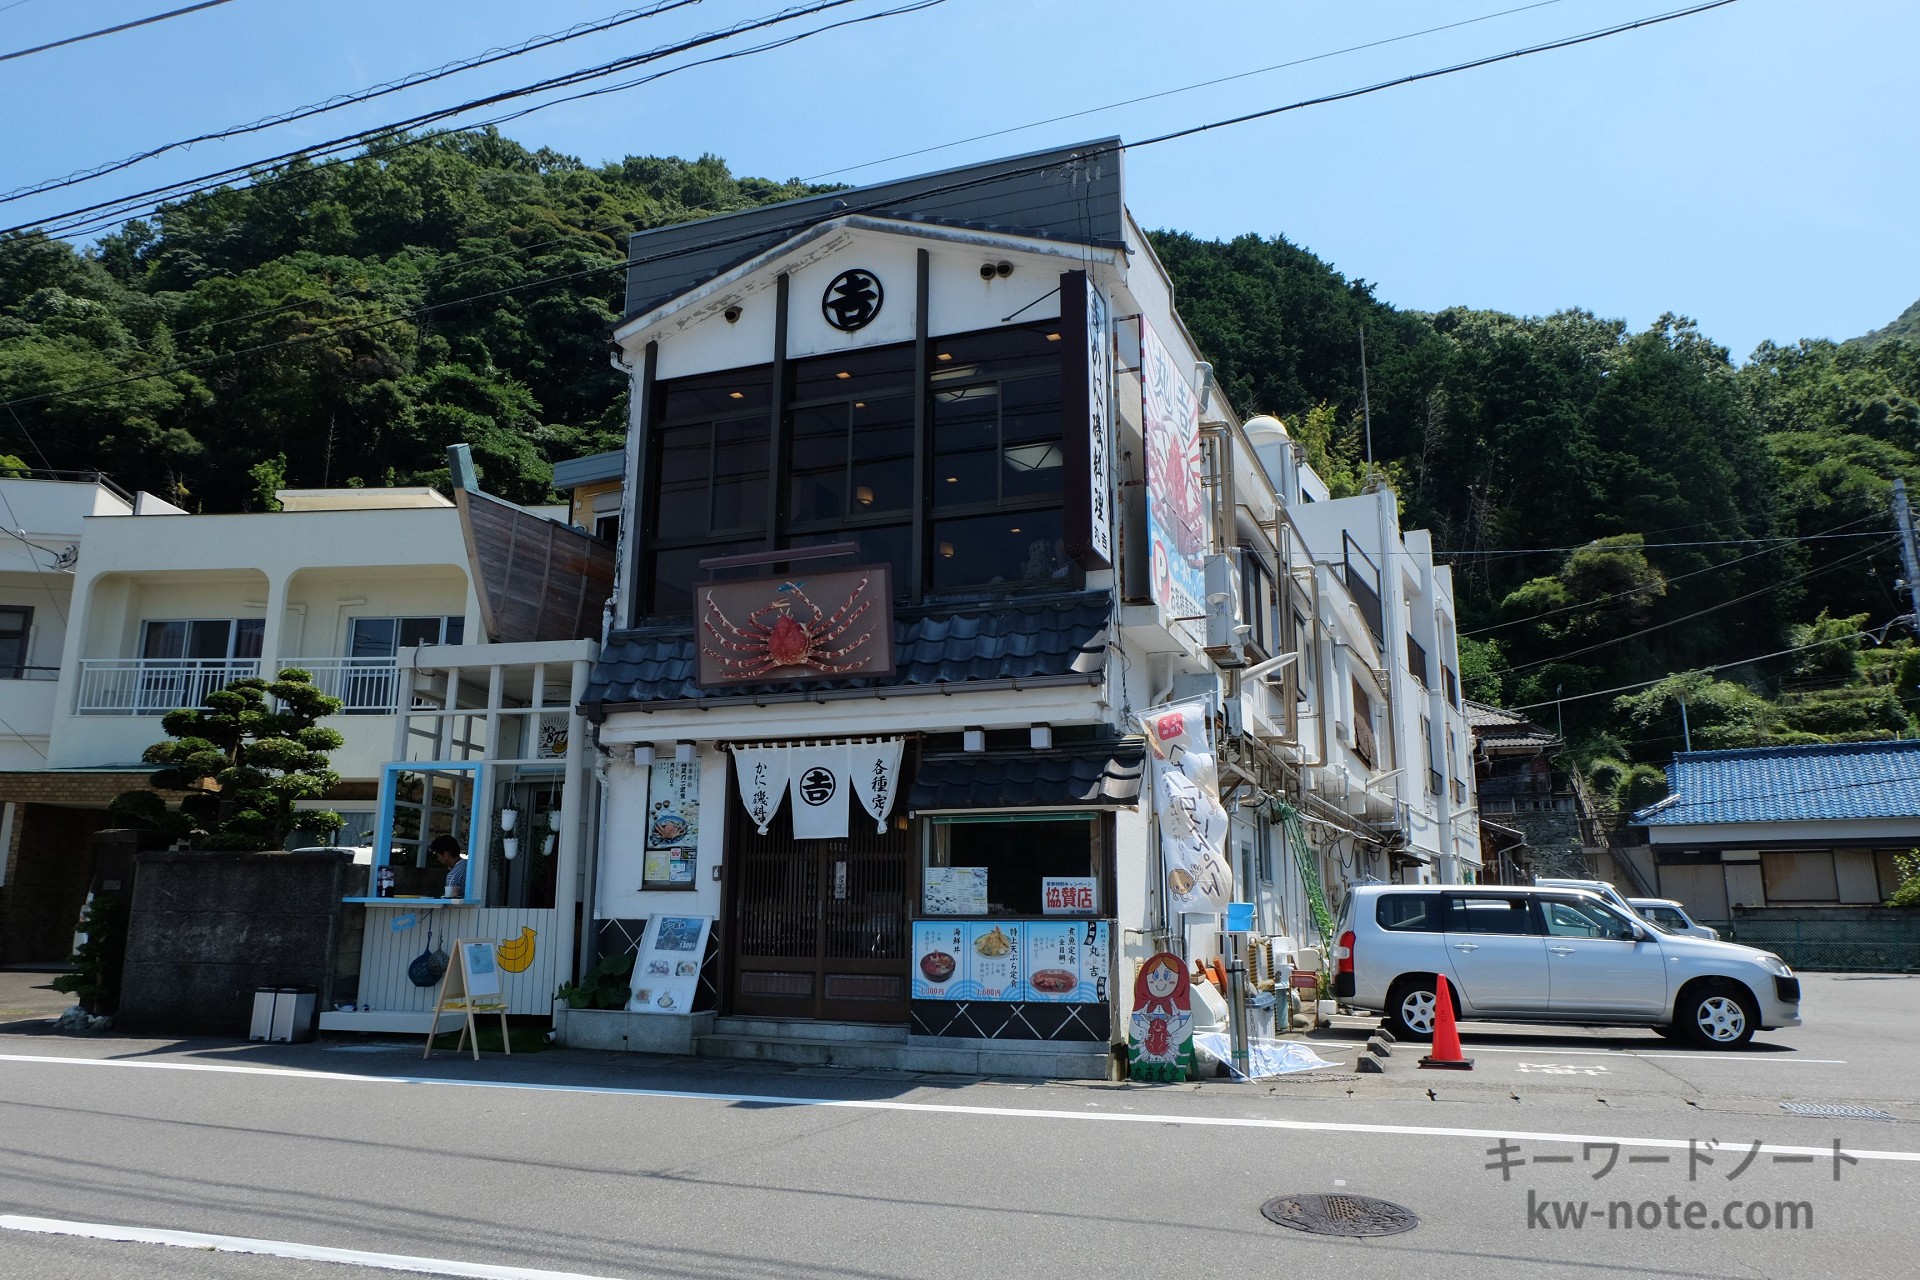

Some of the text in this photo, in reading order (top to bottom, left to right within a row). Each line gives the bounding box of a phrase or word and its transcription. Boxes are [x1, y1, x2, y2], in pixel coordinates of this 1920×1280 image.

[1154, 346, 1192, 441] 丸吉
[1154, 543, 1168, 592] P
[871, 758, 889, 817] 各種定
[1046, 887, 1093, 908] 協賛店
[952, 928, 961, 955] 海鮮丼
[1009, 928, 1018, 988] 特上天ぷら定食
[1067, 927, 1076, 964] 煮魚定食
[1089, 945, 1100, 977] 丸吉
[1133, 1065, 1179, 1081] 丸吉食堂
